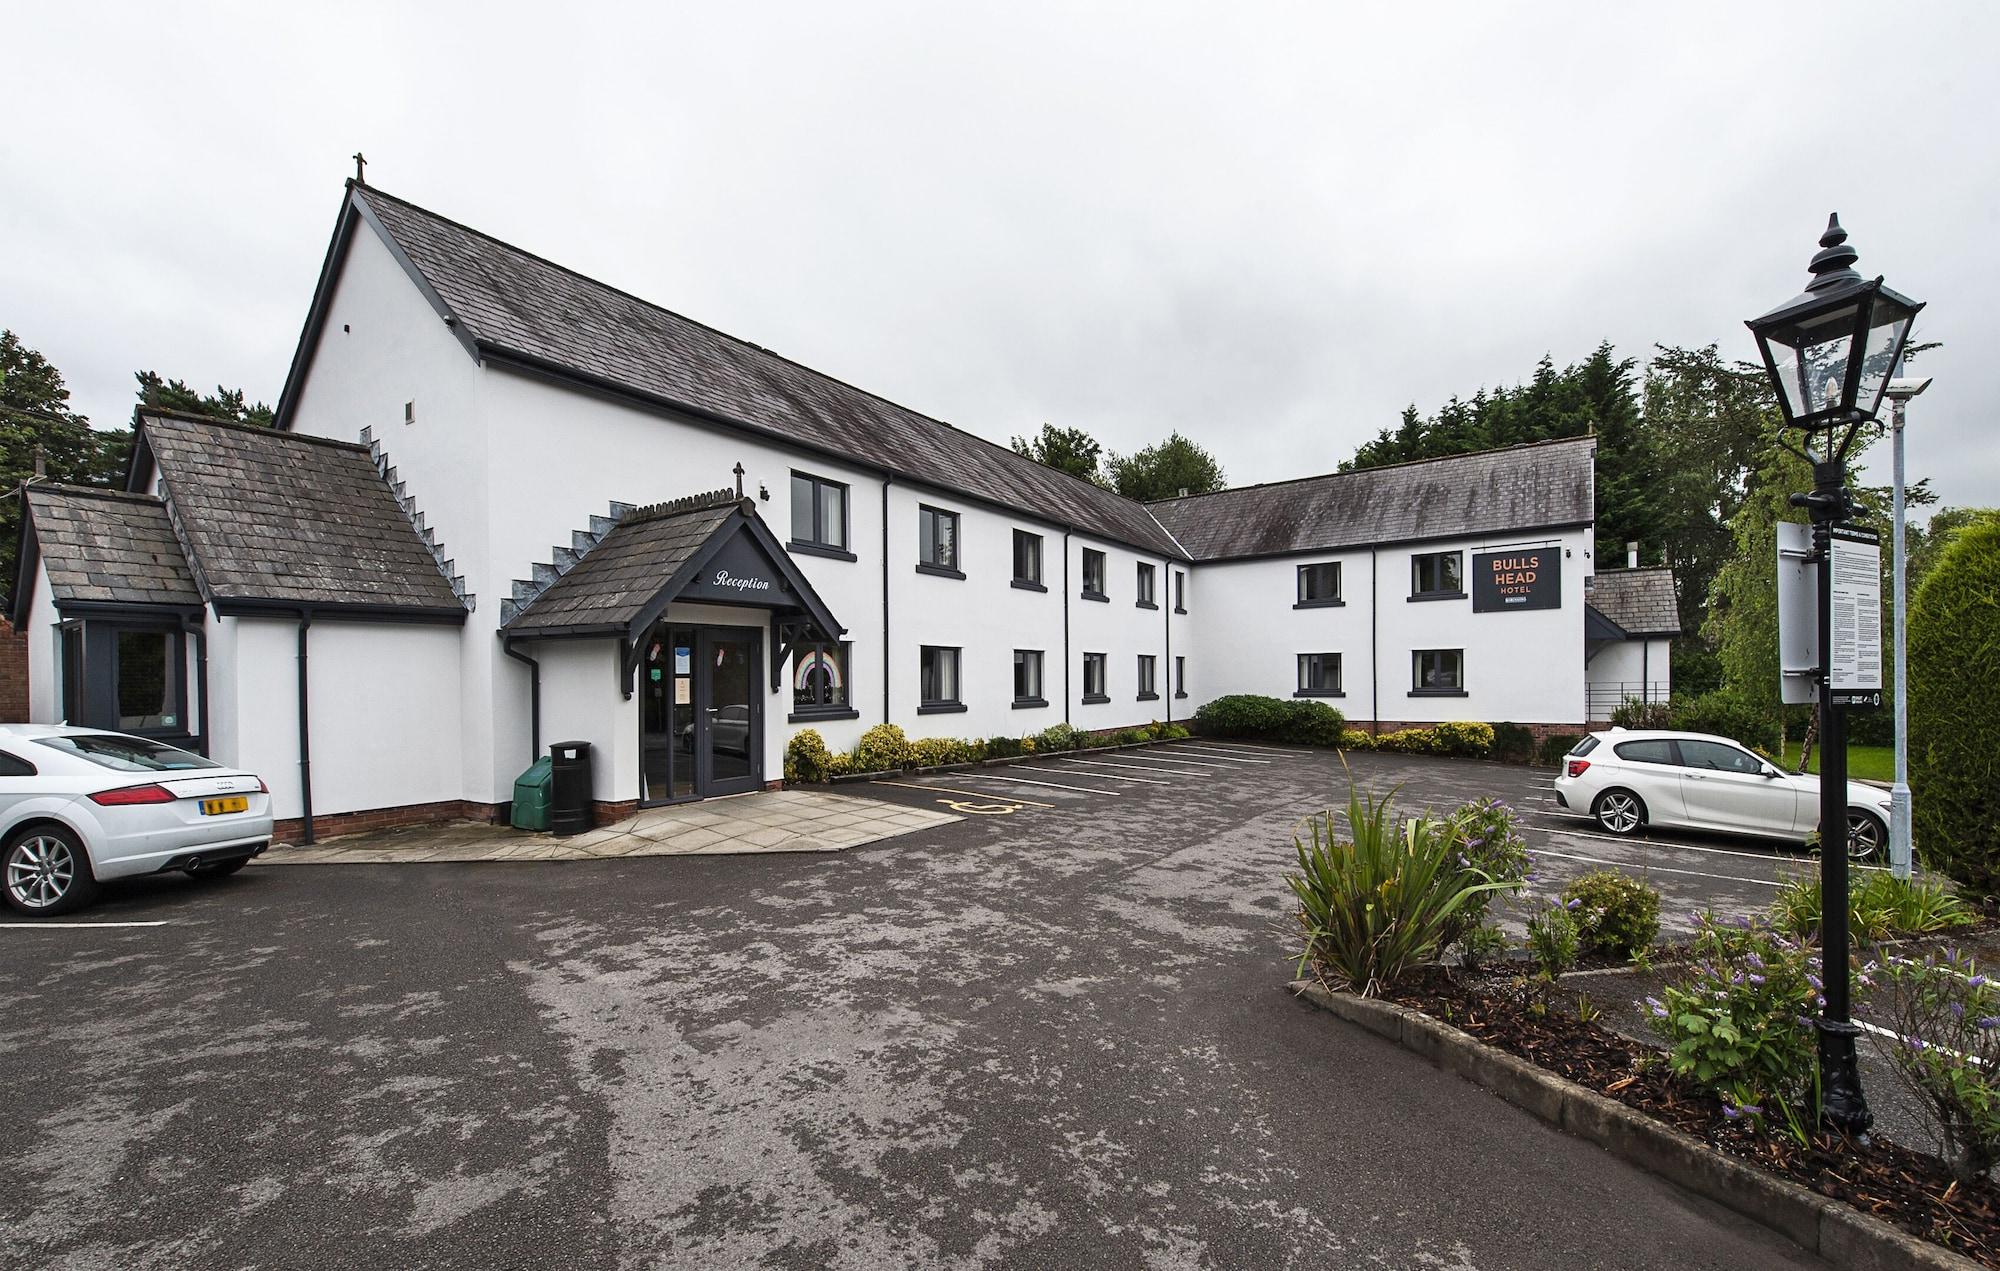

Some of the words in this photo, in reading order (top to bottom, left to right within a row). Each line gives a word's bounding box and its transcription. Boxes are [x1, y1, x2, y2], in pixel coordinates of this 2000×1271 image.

[1492, 556, 1539, 571] BULLS
[712, 570, 769, 591] Reception
[1495, 571, 1536, 585] HEAD
[1500, 586, 1531, 594] HOTEL
